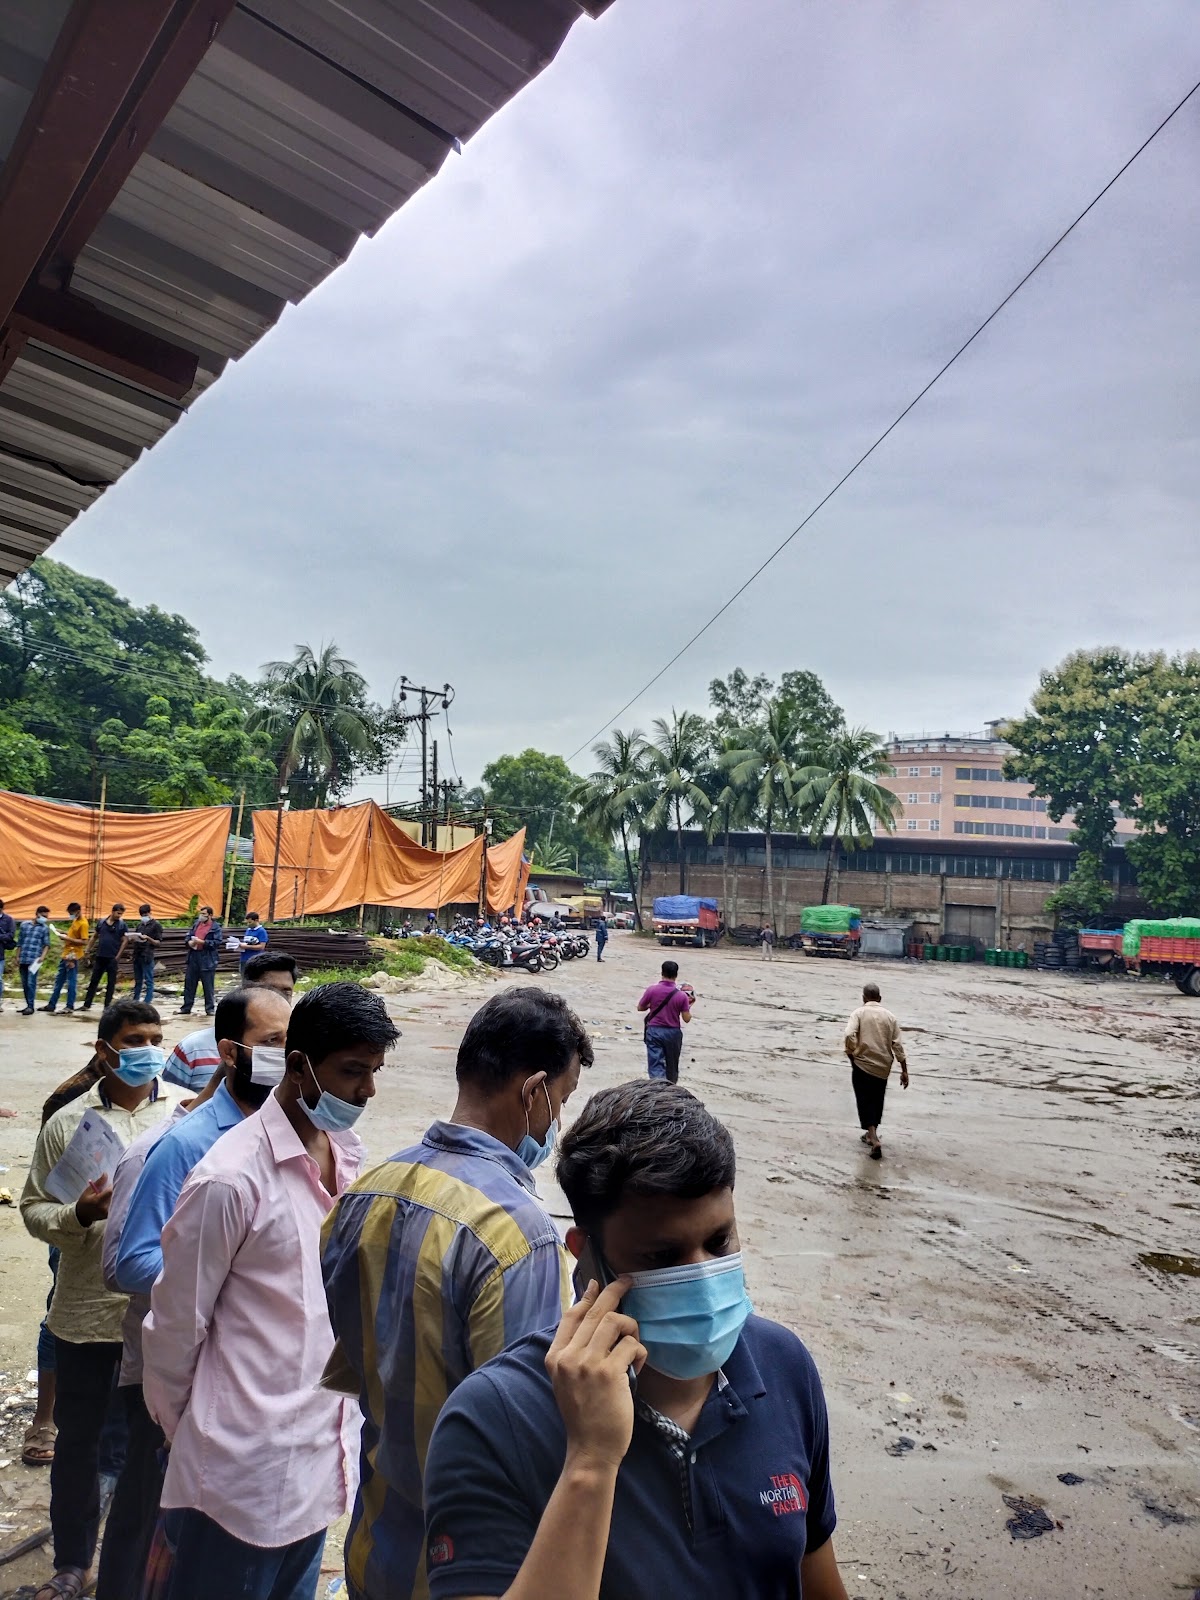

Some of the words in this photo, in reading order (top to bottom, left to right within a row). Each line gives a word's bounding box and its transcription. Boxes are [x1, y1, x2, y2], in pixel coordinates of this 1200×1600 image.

[769, 1474, 790, 1489] THE
[759, 1486, 793, 1505] NORTH
[772, 1499, 797, 1516] FACE
